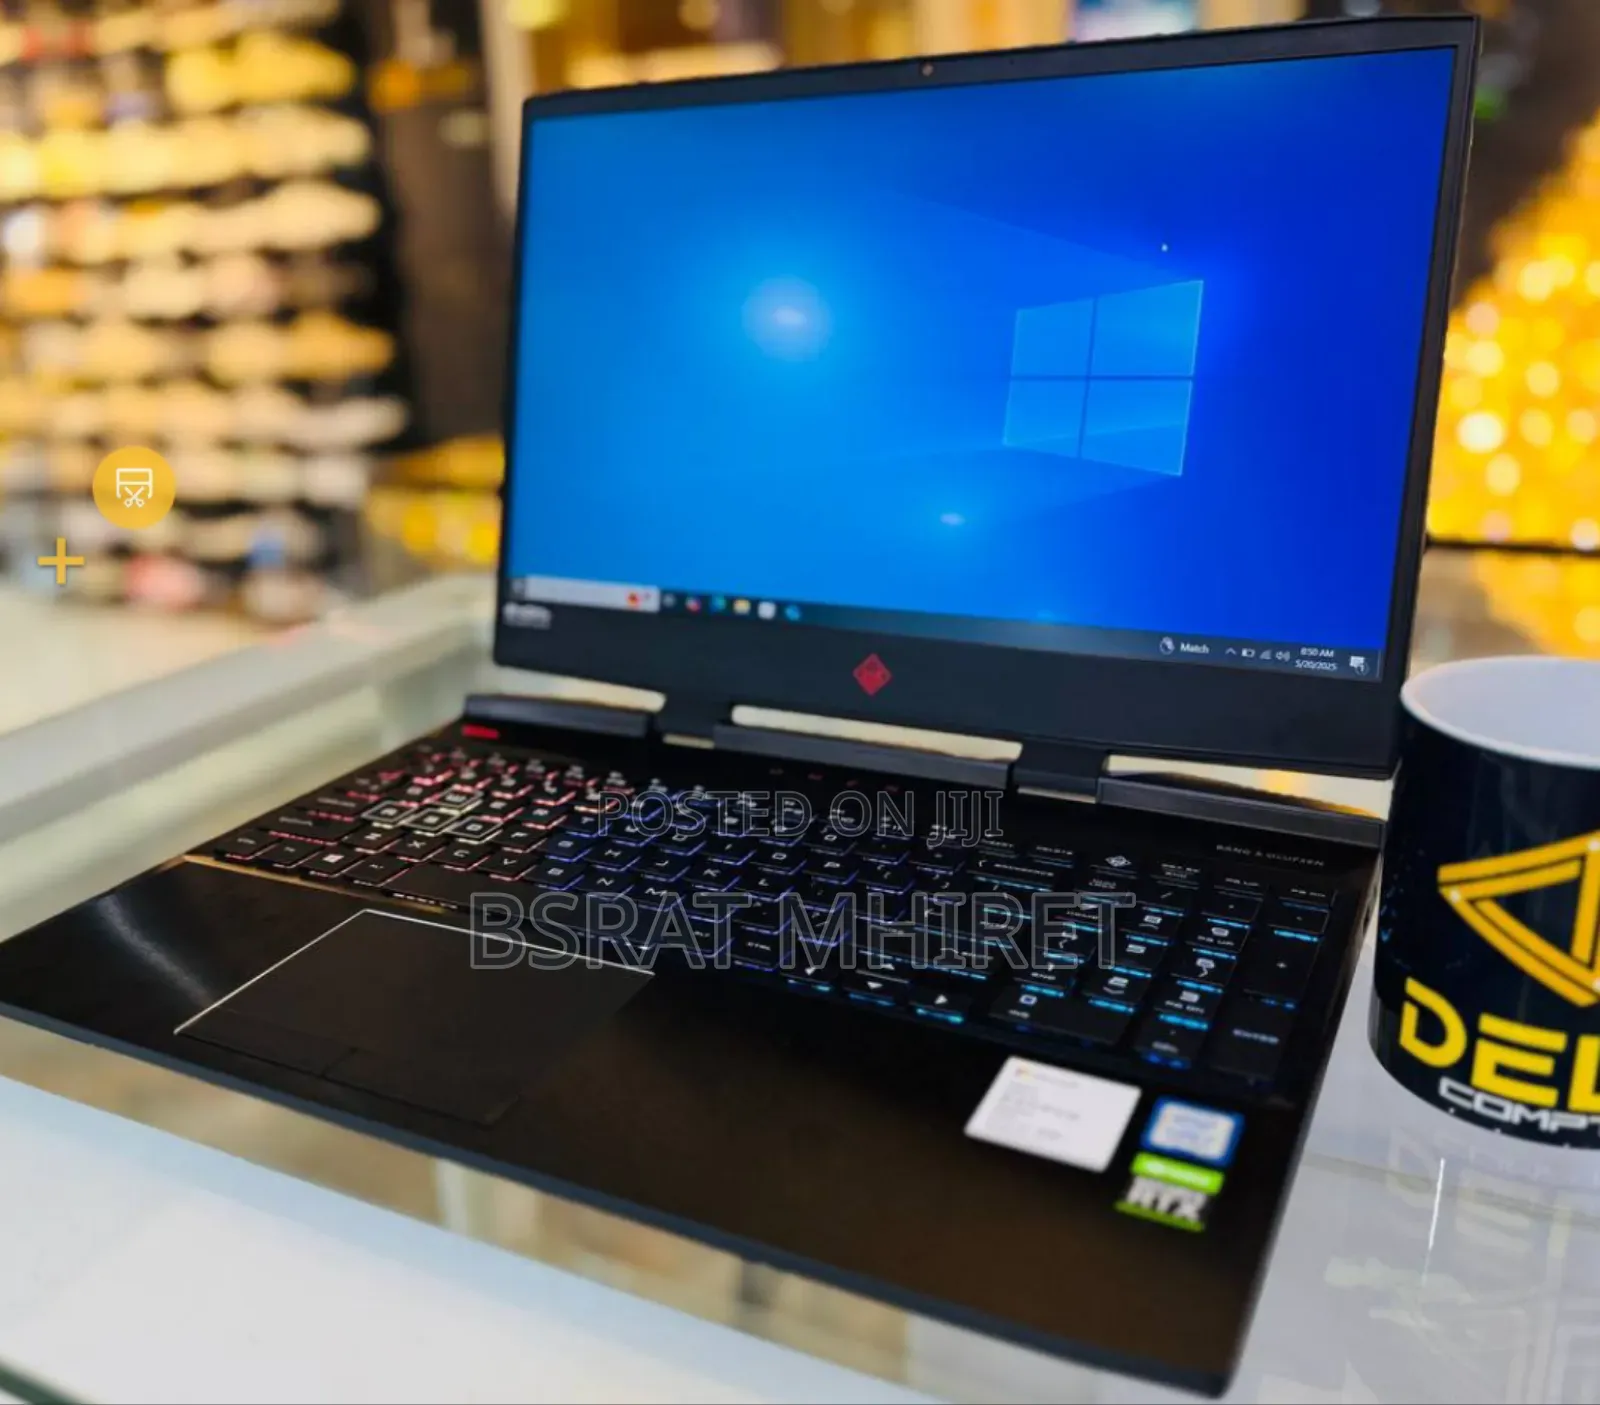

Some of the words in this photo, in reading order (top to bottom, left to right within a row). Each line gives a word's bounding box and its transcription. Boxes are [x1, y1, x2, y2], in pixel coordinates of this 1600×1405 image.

[1180, 642, 1210, 654] Match
[1319, 649, 1335, 658] AM
[1294, 659, 1338, 671] 5/20/2025
